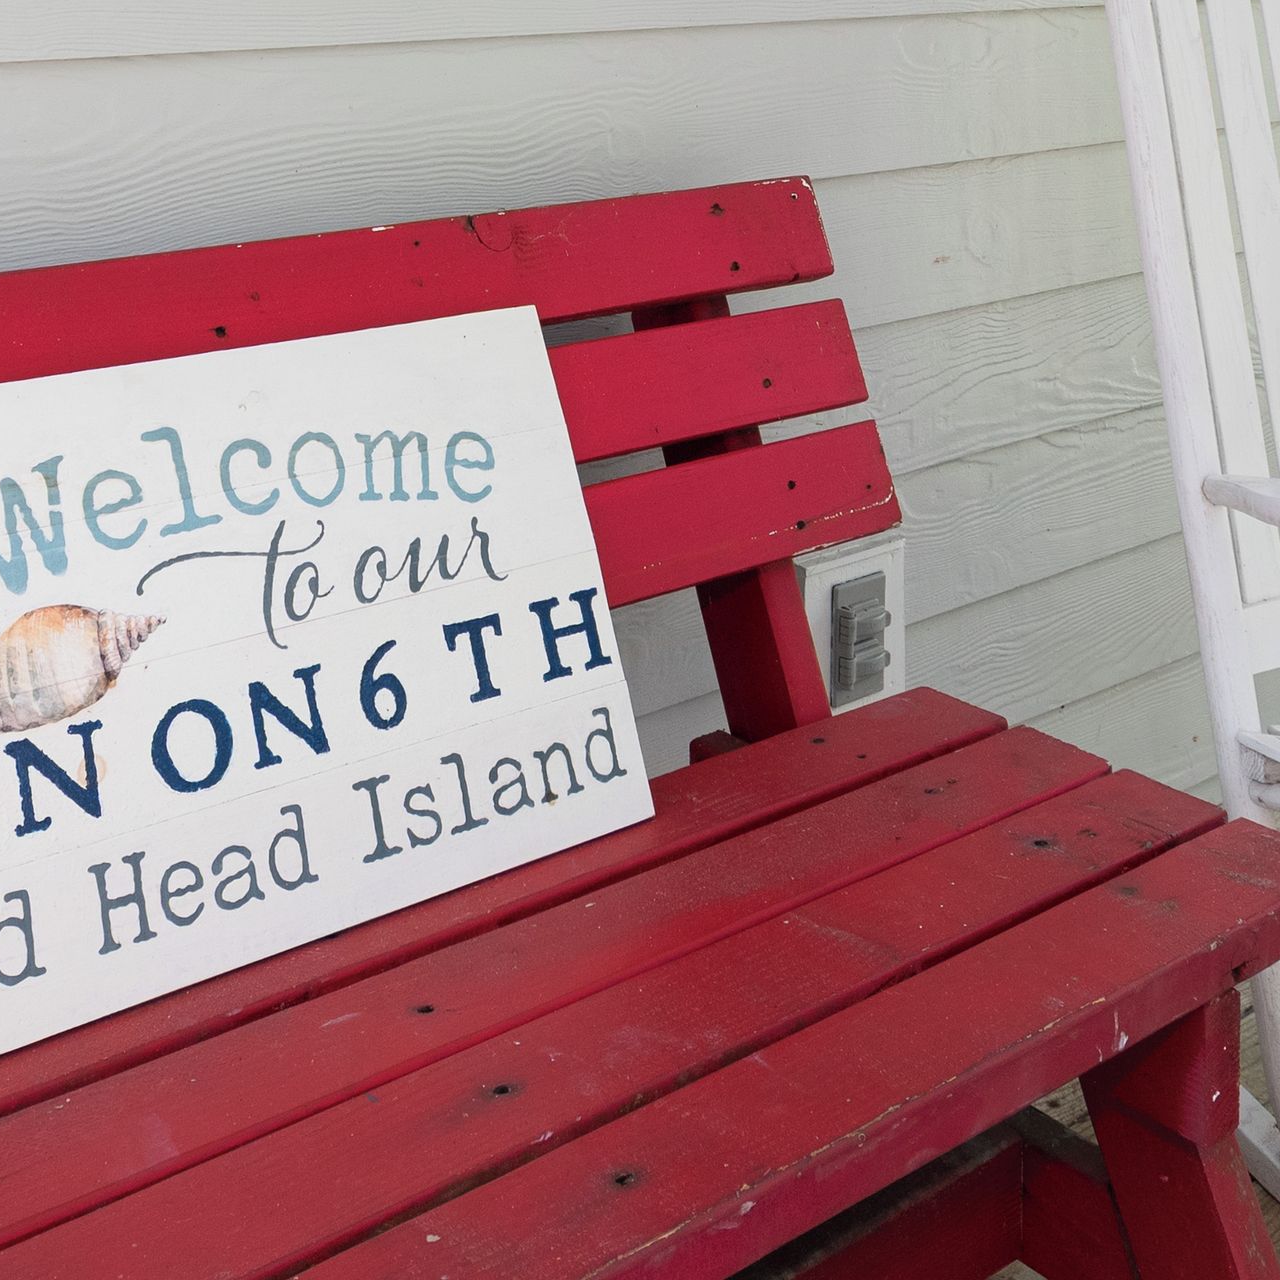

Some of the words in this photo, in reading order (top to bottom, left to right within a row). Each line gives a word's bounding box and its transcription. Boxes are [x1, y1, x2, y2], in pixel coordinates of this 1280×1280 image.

[136, 519, 334, 649] to
[354, 516, 508, 605] our
[149, 663, 333, 793] ON
[93, 803, 319, 956] Head
[351, 706, 628, 864] Island
